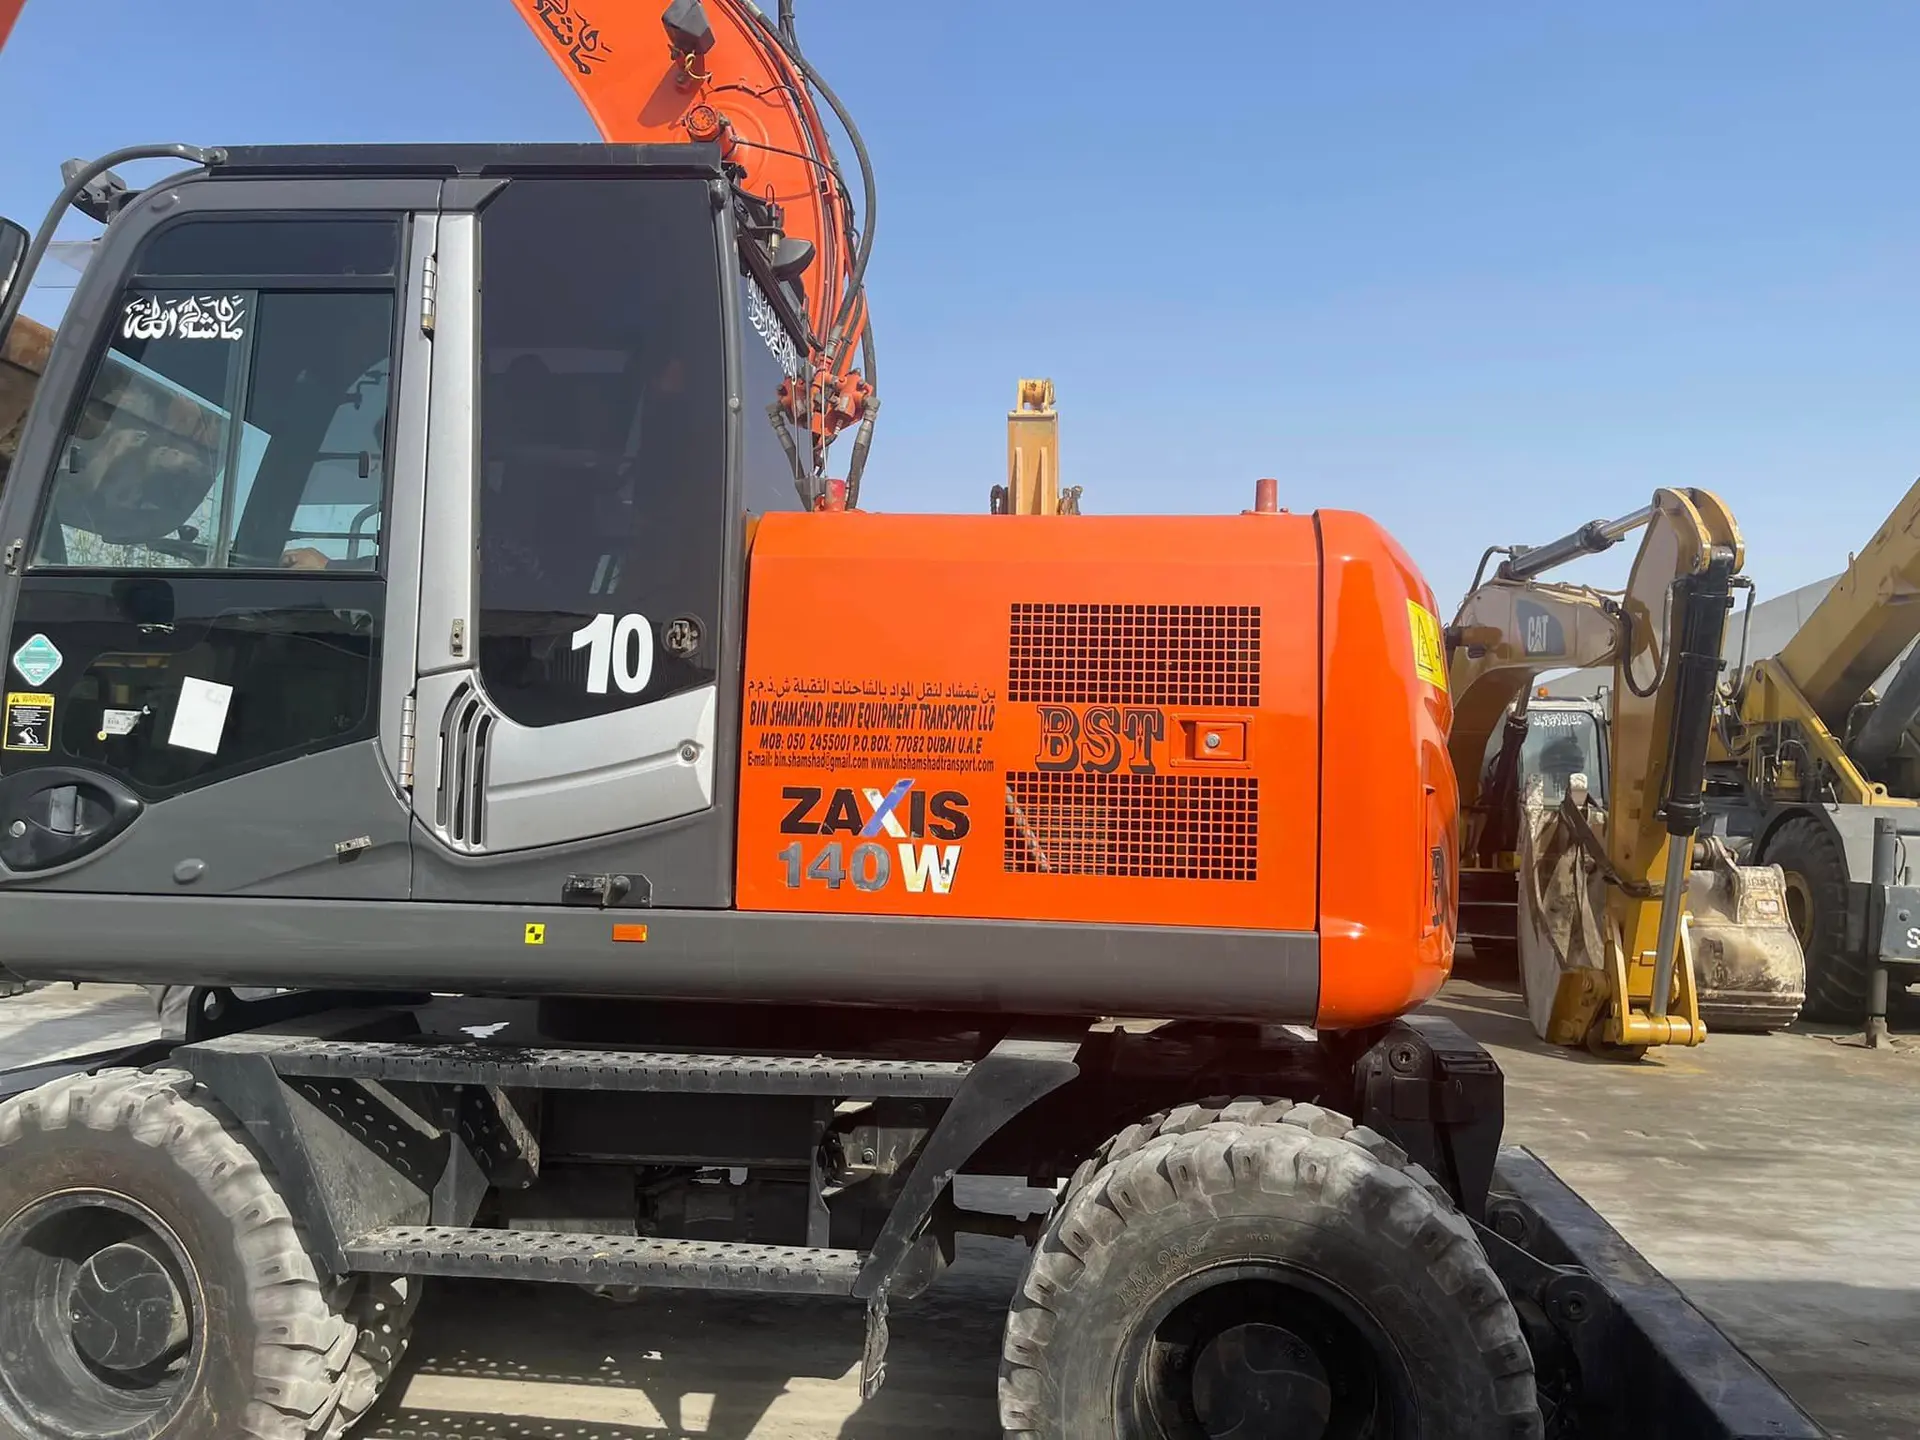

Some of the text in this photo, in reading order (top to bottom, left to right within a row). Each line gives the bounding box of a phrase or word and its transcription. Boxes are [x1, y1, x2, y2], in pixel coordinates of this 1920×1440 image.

[1527, 614, 1549, 652] CAT
[571, 613, 654, 694] 10
[832, 679, 887, 700] بالشاحنات
[890, 680, 914, 702] المواد
[916, 682, 943, 701] لنقل
[945, 682, 979, 699] شمشاد
[981, 687, 996, 704] بن
[749, 700, 996, 732] BIN SHAMSHAD HEAVY EQUIPMENT TRANSPORT LLC
[759, 732, 784, 751] MOB:
[787, 732, 806, 751] 050
[810, 733, 851, 752] 2455001
[894, 735, 925, 754] 77082
[926, 736, 957, 754] DUBAI
[1034, 704, 1165, 774] BST
[747, 750, 994, 776] E-mail: bin.shamshad@gmail.com www.binshamshadtransport.com
[779, 778, 972, 842] ZAXIS
